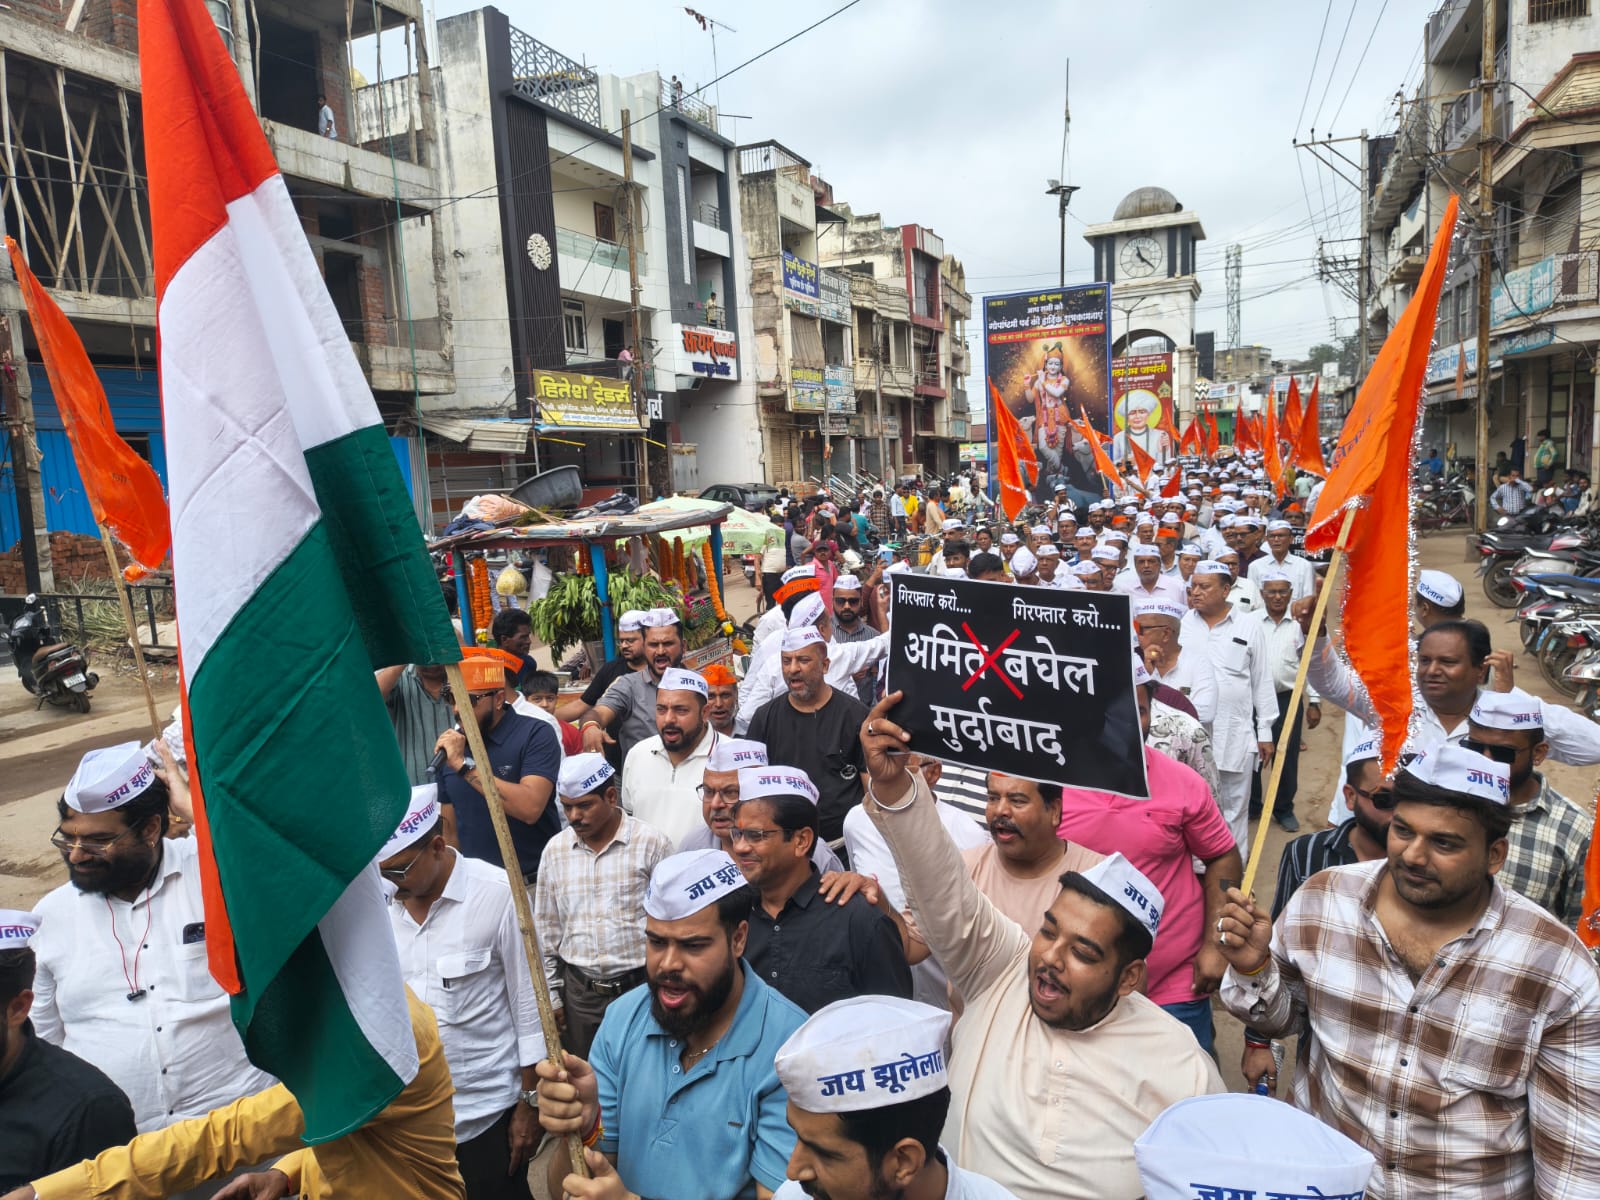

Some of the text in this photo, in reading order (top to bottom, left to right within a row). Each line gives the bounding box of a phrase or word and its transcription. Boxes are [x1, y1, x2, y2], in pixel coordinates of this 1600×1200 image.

[540, 376, 630, 406] हितेश ट्रेडर्स
[898, 584, 935, 608] गिरफ्तार
[1012, 597, 1067, 625] गिरफ्तार
[904, 622, 1099, 696] अमित बघेल
[680, 677, 696, 686] जय
[1513, 713, 1530, 724] जय
[929, 696, 1066, 767] मुर्दाबाद
[733, 751, 751, 762] जय
[581, 774, 597, 789] जय
[758, 776, 781, 785] जय
[1467, 768, 1493, 787] जय
[104, 784, 131, 803] जय
[684, 875, 716, 901] जय
[1124, 881, 1149, 911] जय
[817, 1069, 866, 1097] जय
